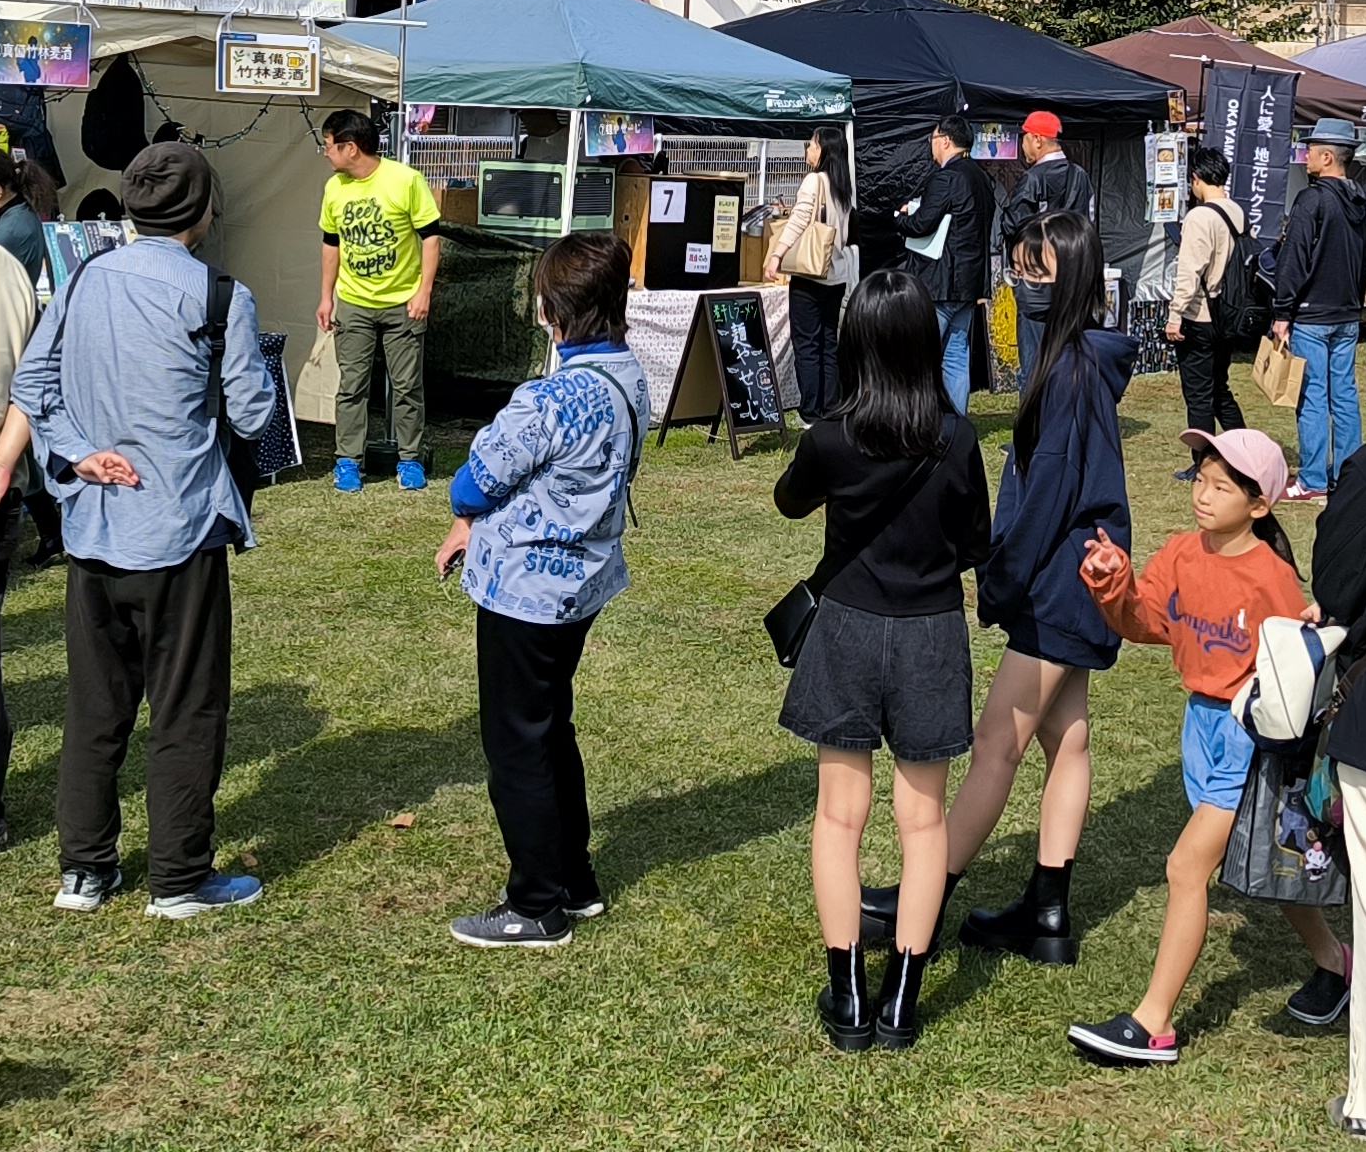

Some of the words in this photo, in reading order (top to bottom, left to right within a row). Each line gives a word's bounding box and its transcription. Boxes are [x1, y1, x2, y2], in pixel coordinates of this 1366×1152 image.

[251, 50, 284, 66] 真備
[237, 65, 305, 82] 竹林麦酒
[1257, 84, 1276, 139] 人に愛、
[343, 197, 383, 226] Beer
[663, 189, 674, 216] 7
[339, 219, 396, 247] MAKES
[347, 248, 397, 277] happy
[543, 519, 585, 543] COO
[523, 548, 586, 581] STOPS
